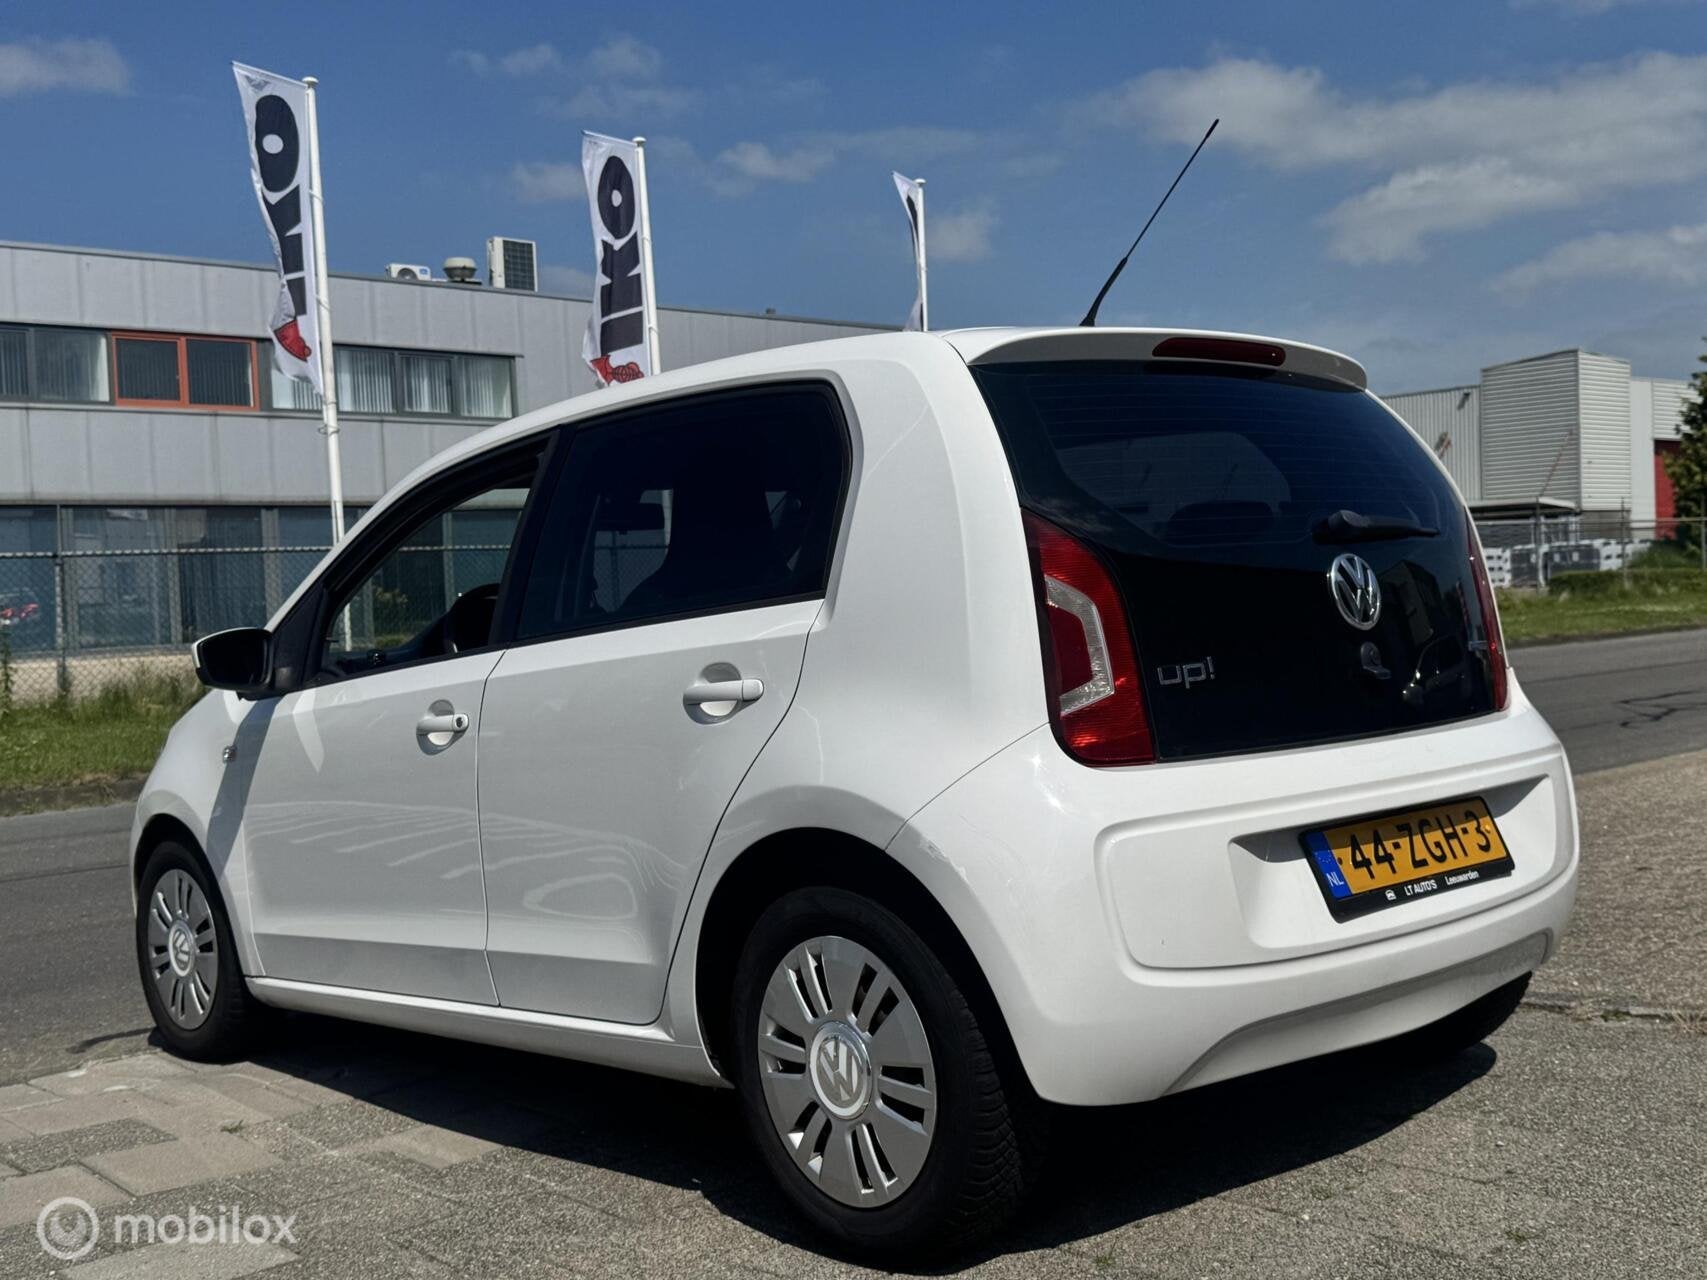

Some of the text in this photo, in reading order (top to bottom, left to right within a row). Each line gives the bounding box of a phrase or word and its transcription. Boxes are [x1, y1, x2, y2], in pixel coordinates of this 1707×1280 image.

[1157, 655, 1215, 689] up!
[1350, 810, 1492, 880] 44-ZGH-3
[1327, 873, 1344, 887] NL
[1404, 884, 1414, 896] LT
